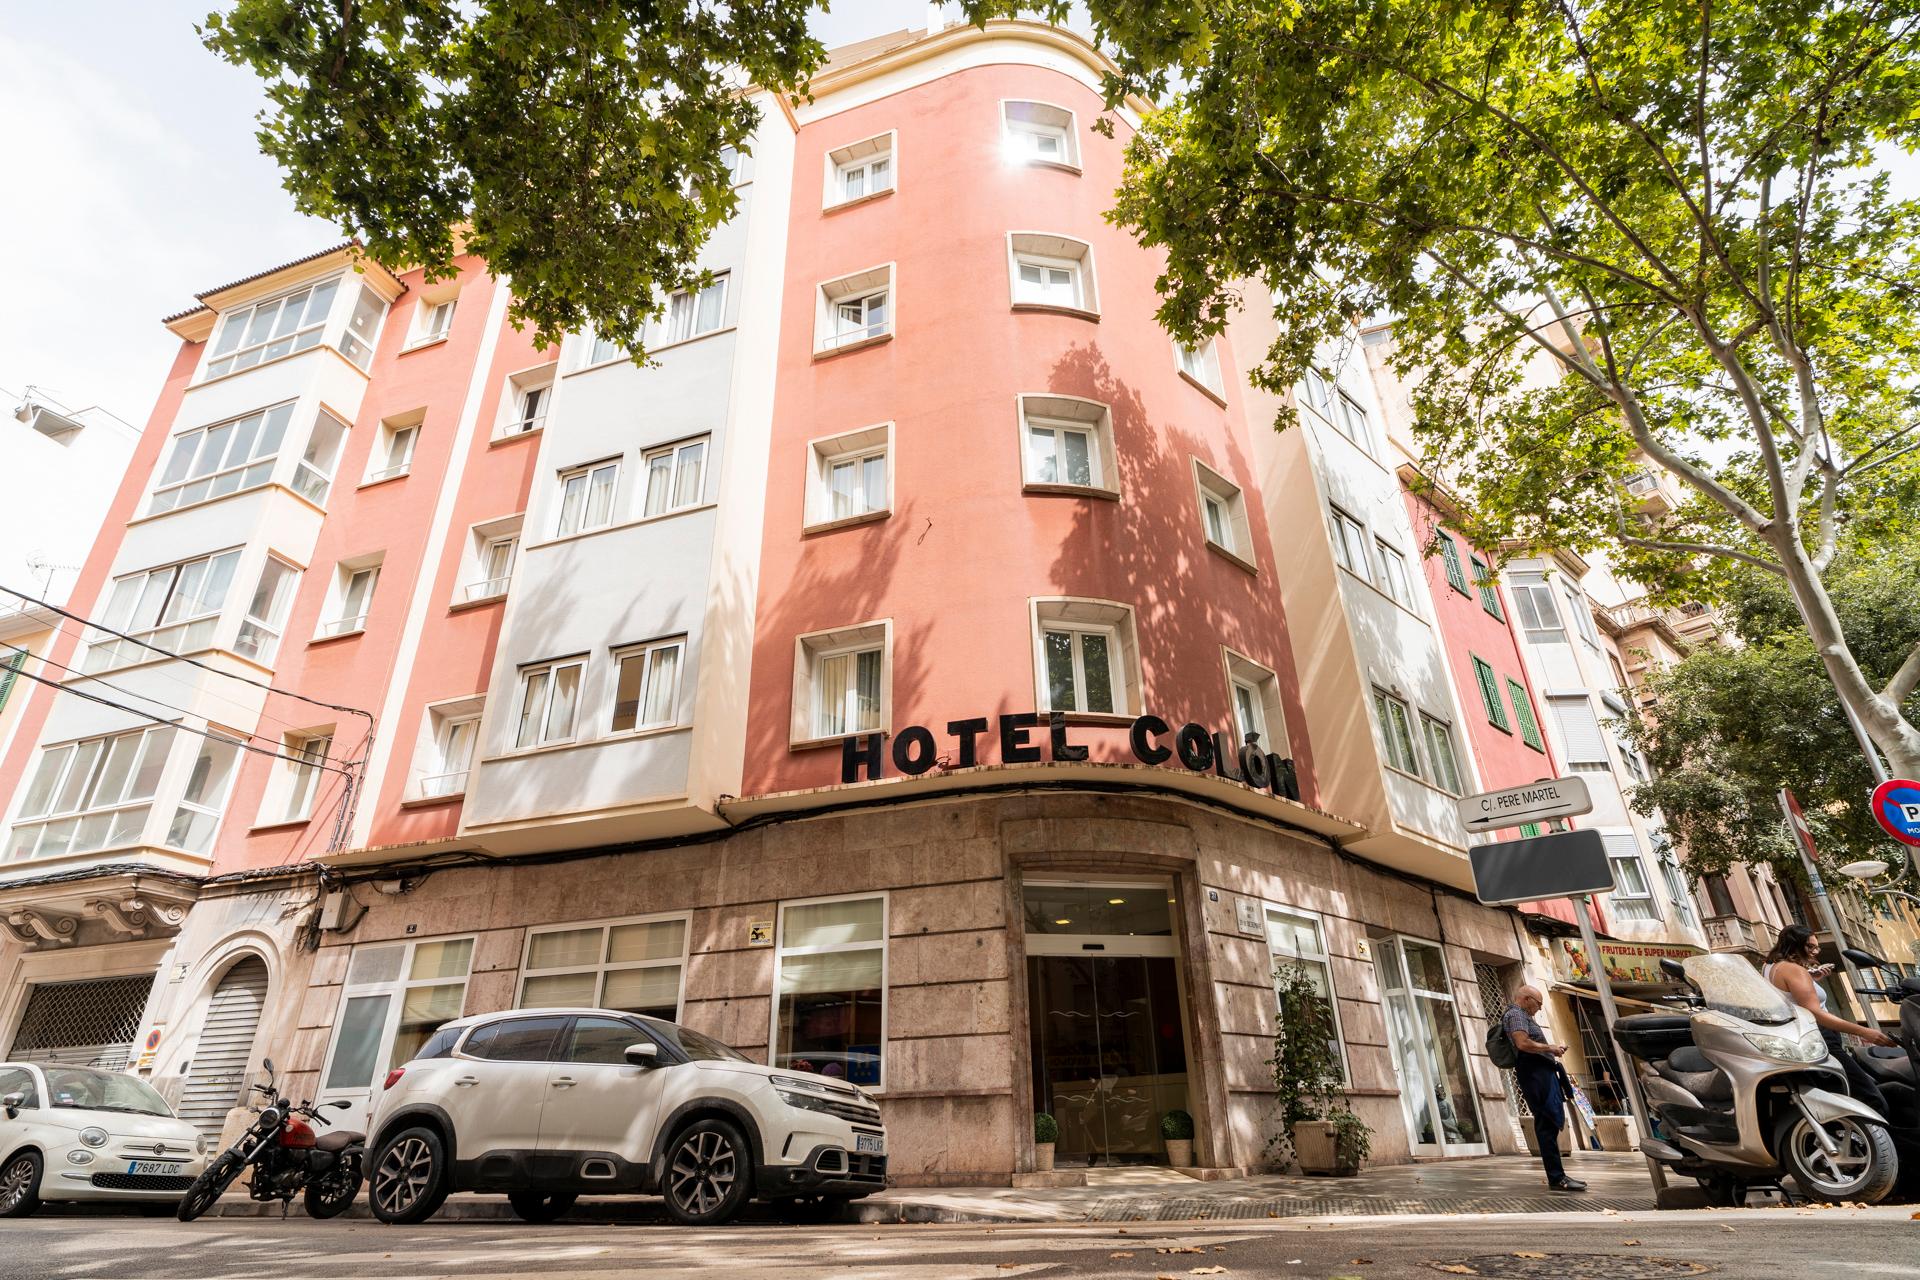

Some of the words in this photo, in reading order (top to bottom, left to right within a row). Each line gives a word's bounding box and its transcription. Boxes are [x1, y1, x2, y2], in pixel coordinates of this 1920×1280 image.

[841, 711, 1089, 783] HOTEL
[1129, 714, 1300, 801] COLÓN
[1497, 793, 1521, 809] PERE
[1522, 786, 1561, 804] MARTEL
[1905, 806, 1919, 820] P
[1601, 945, 1636, 956] FRUTERIA
[1637, 947, 1643, 956] &
[1644, 947, 1665, 957] SUPER
[1666, 949, 1692, 958] MARKET
[136, 1162, 161, 1174] 7687
[162, 1163, 180, 1174] LDC
